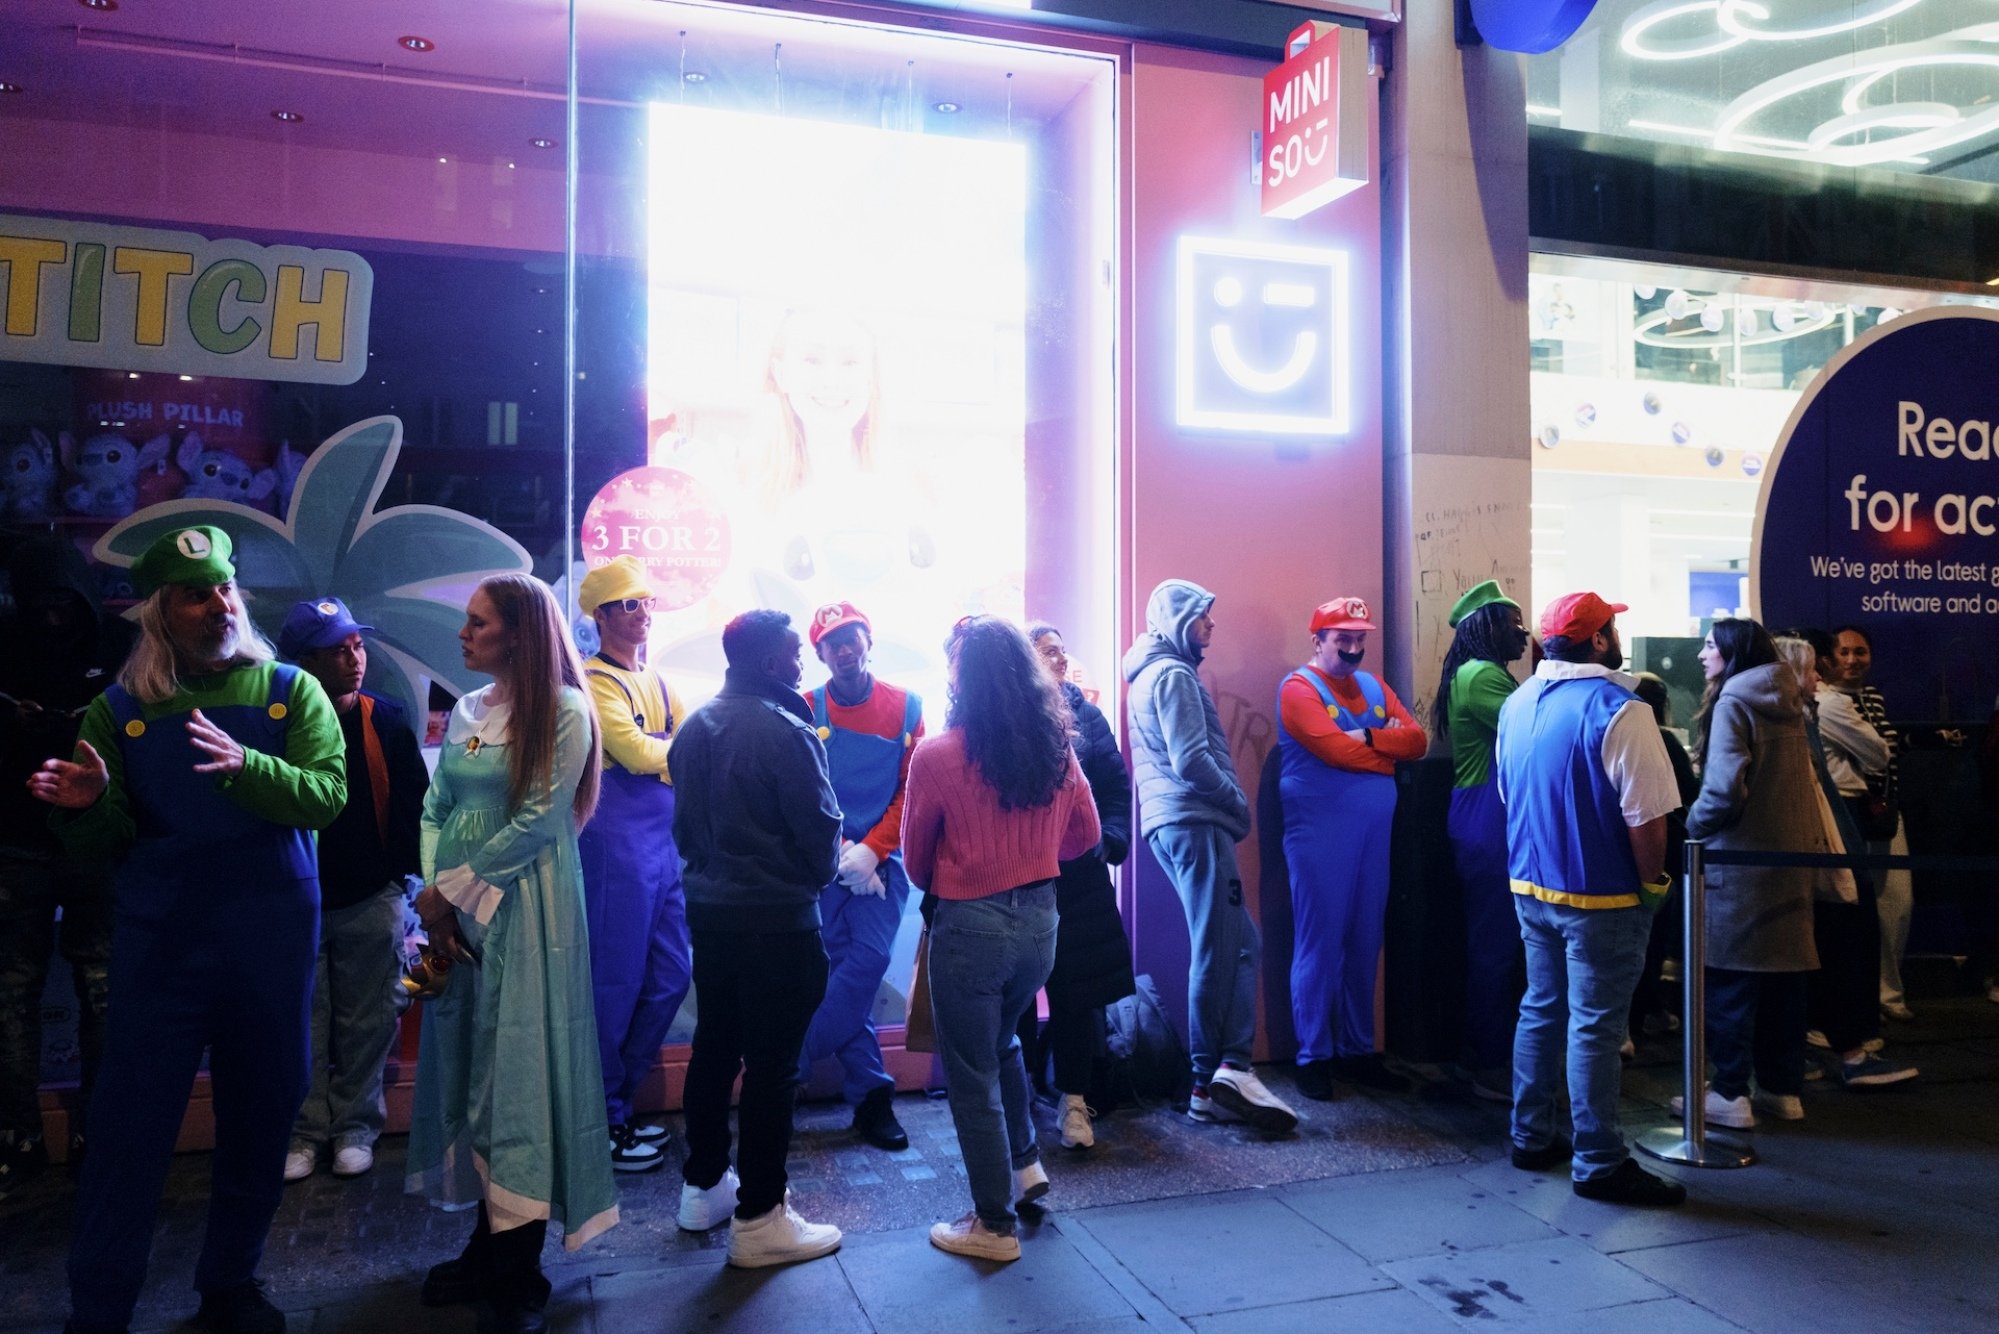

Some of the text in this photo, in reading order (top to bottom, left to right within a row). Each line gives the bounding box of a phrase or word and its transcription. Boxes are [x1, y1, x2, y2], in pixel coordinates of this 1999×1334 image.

[1269, 56, 1330, 133] MINI
[0, 235, 349, 363] TITCH
[88, 401, 245, 427] PLUSH PILLAR
[1898, 400, 1999, 461] Rea
[634, 509, 680, 522] ENJOY
[1844, 475, 1999, 536] for ac
[184, 537, 206, 554] L
[591, 525, 721, 551] 3 FOR 2
[1810, 556, 1865, 578] We've
[1870, 560, 1899, 584] got
[1904, 559, 1933, 579] the
[1937, 560, 1986, 582] latest
[822, 607, 840, 624] M
[1350, 602, 1366, 616] M
[1862, 591, 1999, 614] software and a
[1229, 878, 1242, 907] 3
